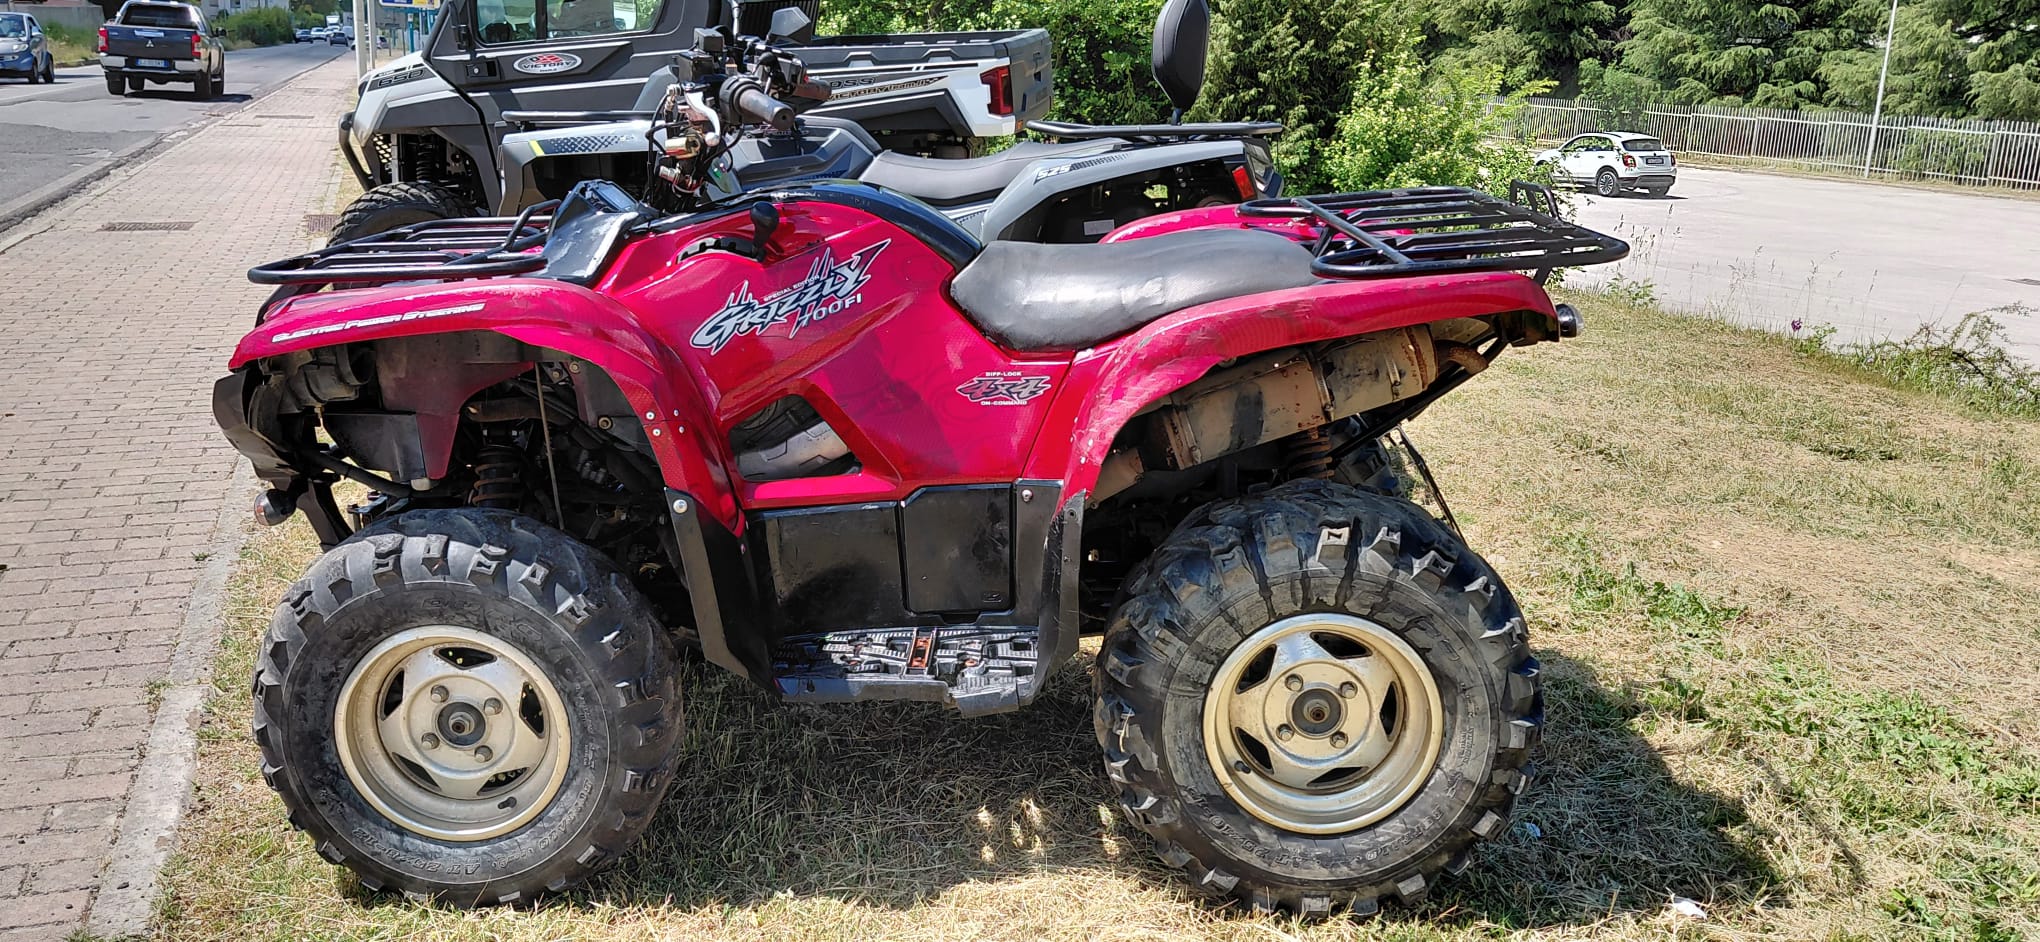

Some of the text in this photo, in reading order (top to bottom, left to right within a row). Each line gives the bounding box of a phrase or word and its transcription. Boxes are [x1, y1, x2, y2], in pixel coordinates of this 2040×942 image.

[523, 61, 572, 69] VICTORY
[690, 240, 891, 355] GRIZZLY
[763, 275, 820, 302] SPECIAL EDITION
[271, 302, 486, 343] ELECTRIC POWER STEERING
[797, 292, 863, 330] 700FI
